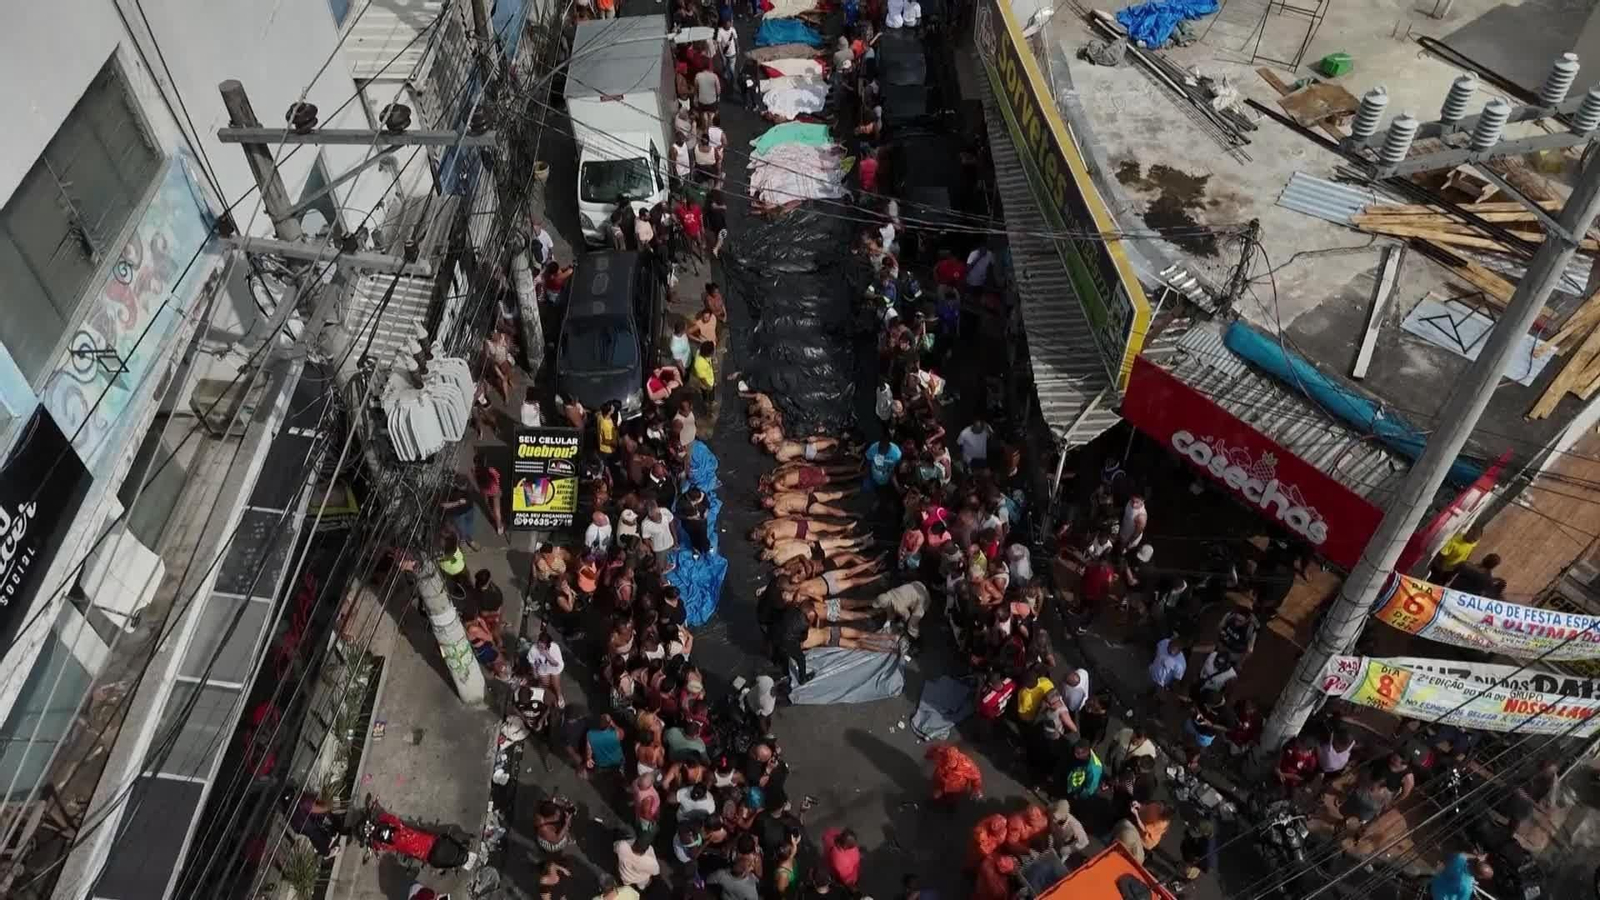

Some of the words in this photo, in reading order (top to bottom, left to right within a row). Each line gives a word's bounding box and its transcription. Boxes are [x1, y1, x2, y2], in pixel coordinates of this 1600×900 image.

[998, 28, 1067, 209] Sorvetes
[518, 436, 536, 444] SEU
[538, 436, 578, 445] CELULAR
[517, 444, 578, 458] Quebrou?
[1481, 614, 1495, 626] A
[1506, 605, 1521, 619] DE
[1524, 608, 1561, 625] FESTA
[1381, 666, 1400, 677] DIA
[1377, 674, 1394, 697] 8
[1429, 675, 1465, 690] EDIÇÃO
[1463, 688, 1476, 696] DO
[1494, 693, 1506, 701] DO
